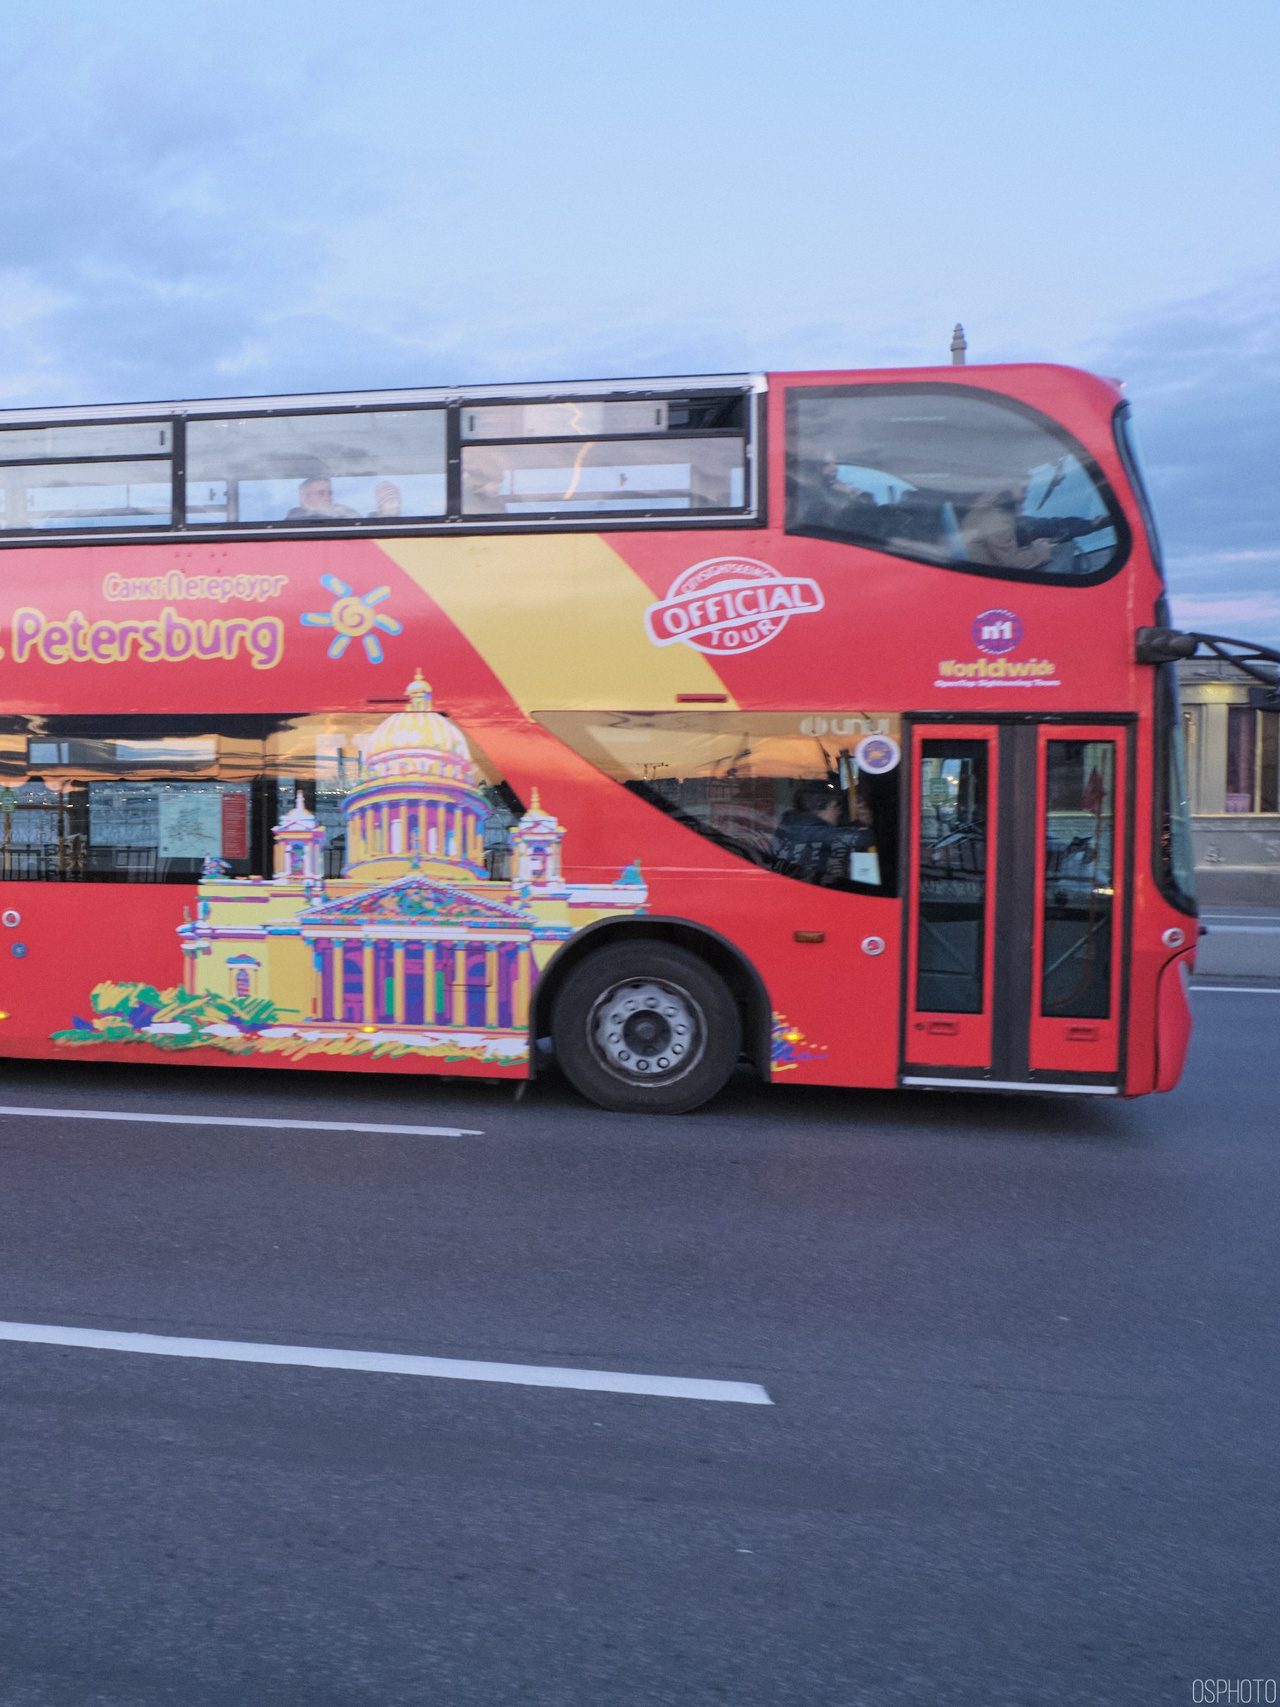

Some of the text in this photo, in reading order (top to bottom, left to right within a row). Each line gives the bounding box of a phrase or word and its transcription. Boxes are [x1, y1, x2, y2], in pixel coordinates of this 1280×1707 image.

[663, 584, 812, 634] OFFICIAL
[710, 619, 776, 647] TOUR
[12, 606, 284, 670] Petersburg
